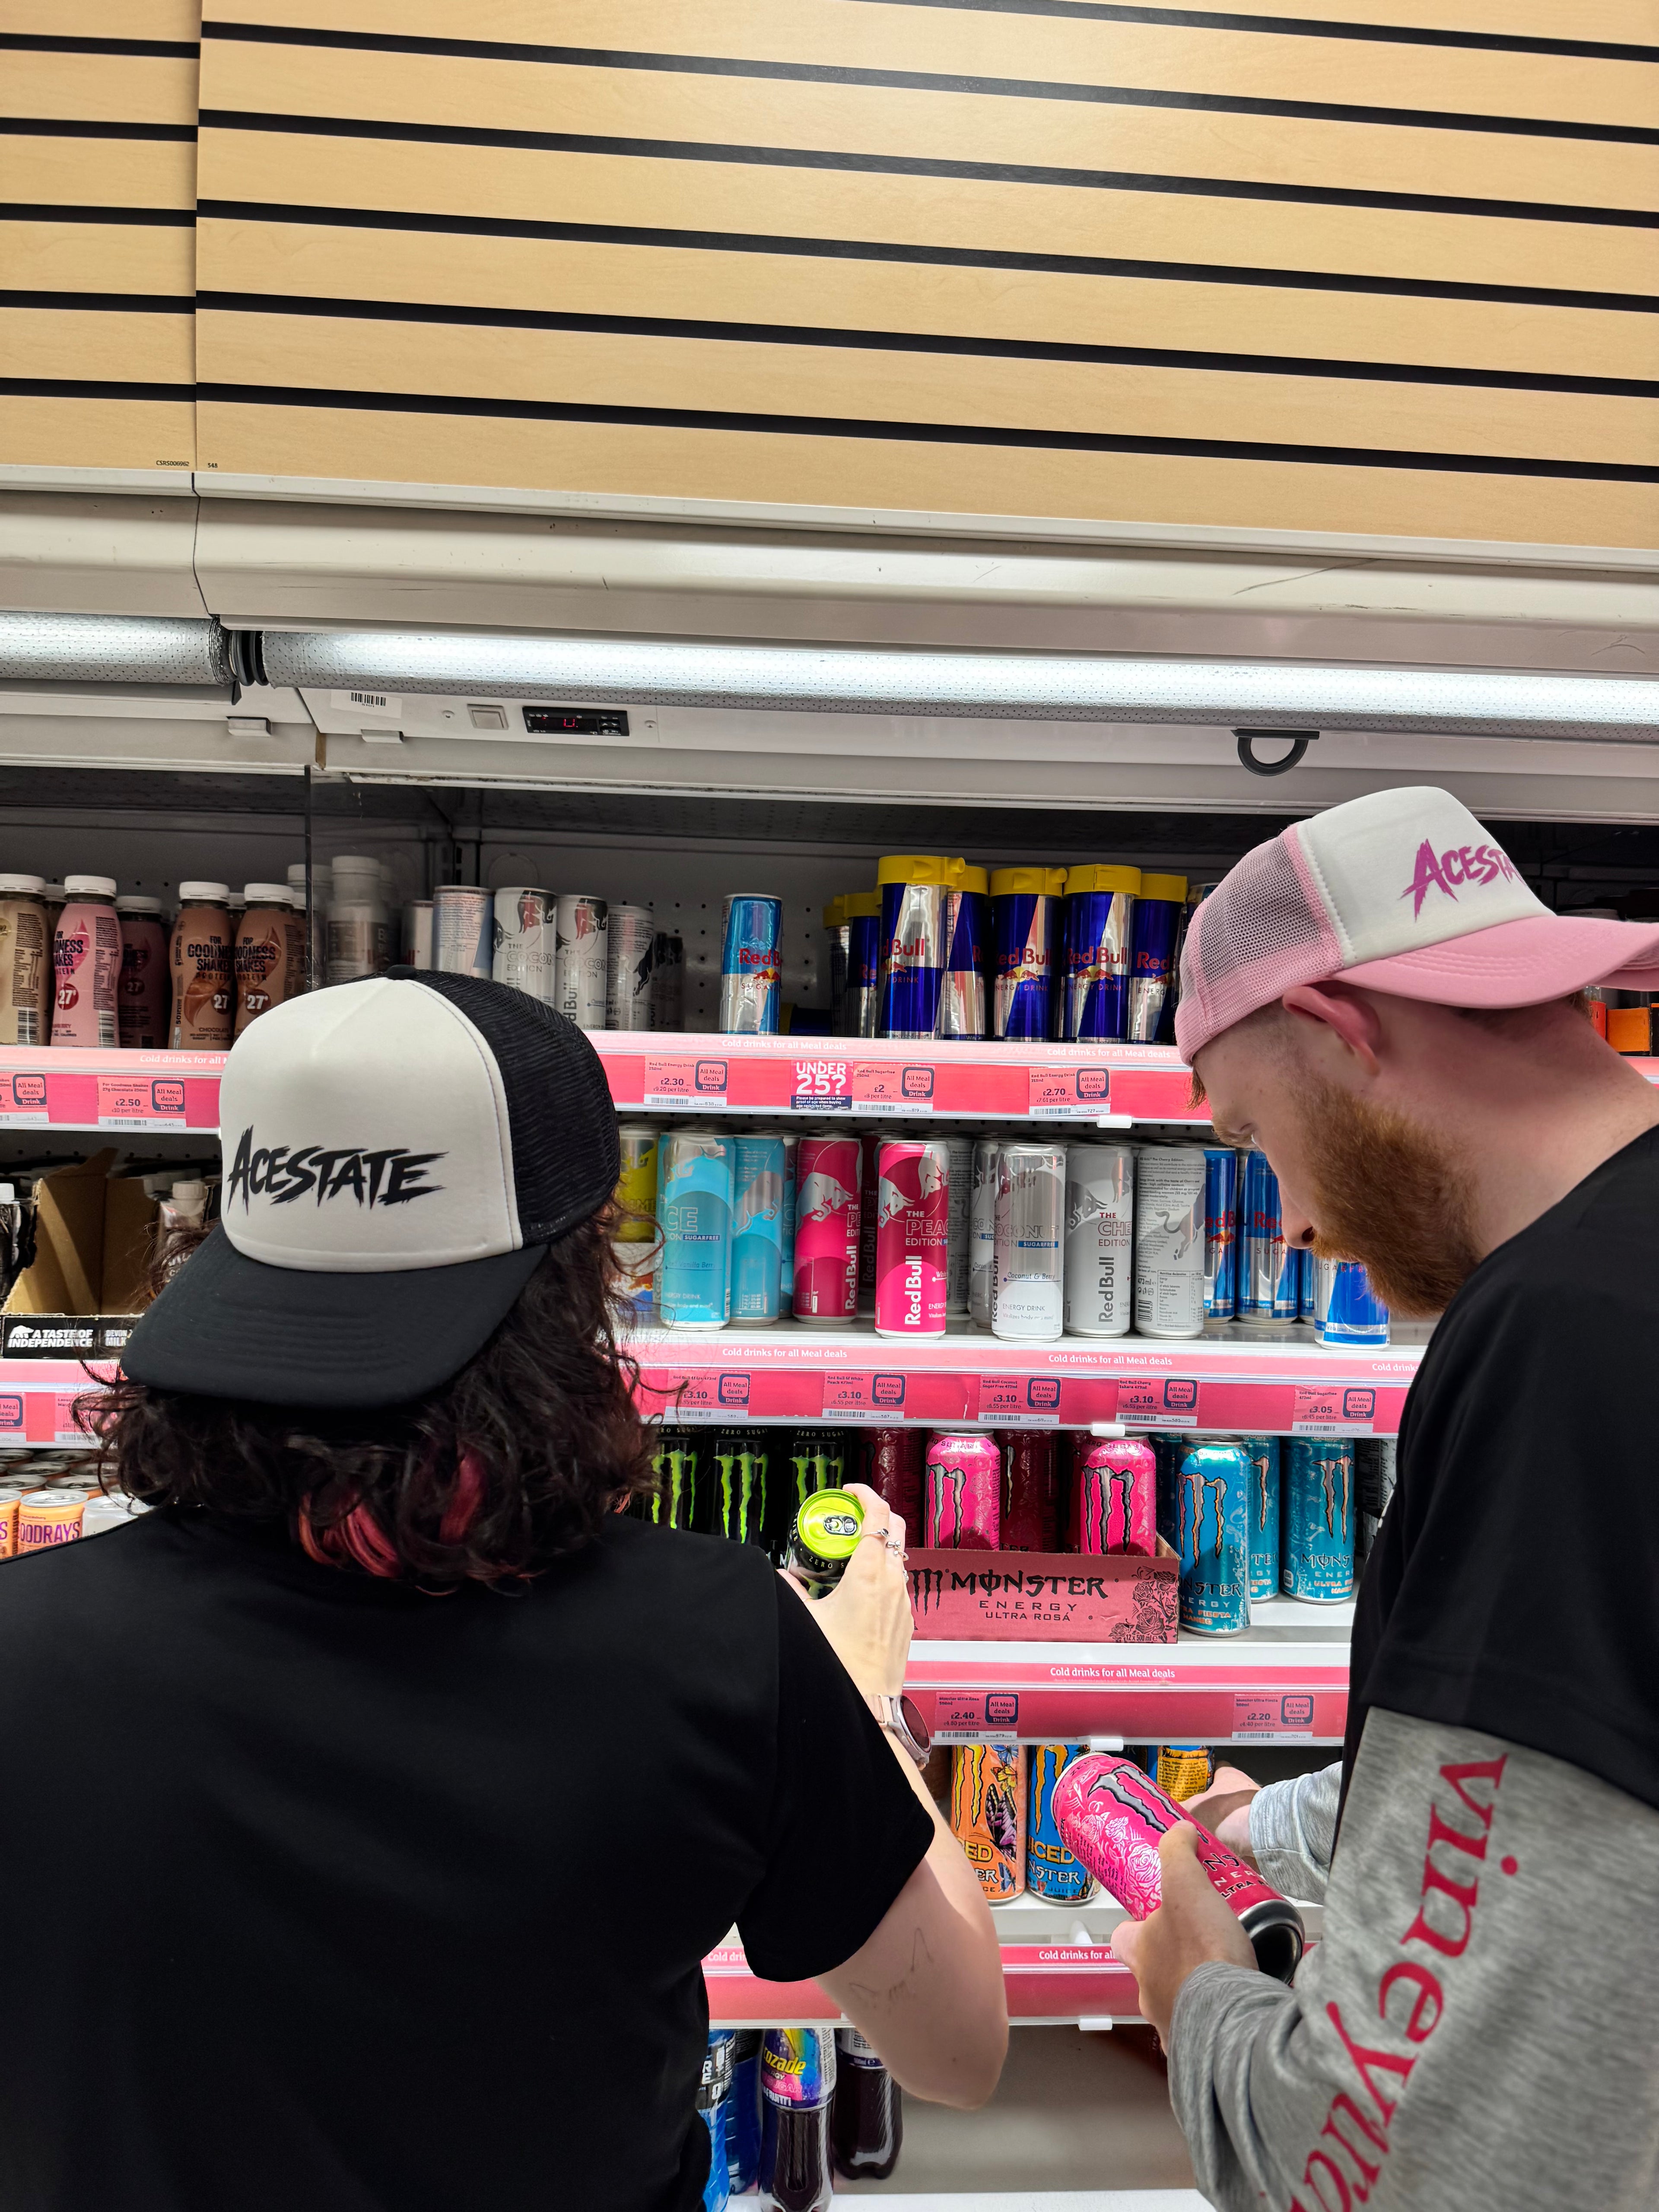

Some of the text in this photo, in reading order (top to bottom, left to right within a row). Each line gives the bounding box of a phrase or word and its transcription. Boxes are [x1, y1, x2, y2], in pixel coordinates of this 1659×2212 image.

[891, 938, 925, 956] Bull
[739, 948, 770, 966] Red
[1096, 947, 1127, 964] Bull
[722, 1039, 847, 1050] Cold drinks for all Meal deals
[140, 1055, 222, 1065] Cold drinks for all
[1147, 1050, 1170, 1058] deals
[796, 1061, 846, 1075] UNDER
[796, 1074, 846, 1095] 25?
[874, 1084, 884, 1093] £2
[227, 1125, 449, 1216] ACESTATE
[906, 1238, 942, 1246] EDITION
[846, 1245, 857, 1276] Bull
[906, 1255, 922, 1288] Bull
[1099, 1256, 1114, 1287] Bull
[845, 1278, 856, 1309] Red
[904, 1290, 922, 1325] Red
[1098, 1290, 1113, 1322] Red
[32, 1329, 93, 1338] A TASTE OF
[8, 1338, 93, 1348] INDEPENDENCE
[722, 1348, 847, 1358] Cold drinks for all Meal deals
[1069, 1355, 1097, 1363] drinks
[1100, 1356, 1112, 1364] for
[1126, 1357, 1147, 1365] Meal
[1149, 1357, 1172, 1366] deals
[809, 1556, 833, 1568] ZERO
[951, 1569, 1108, 1599] MONSTER
[979, 1600, 1077, 1612] ENERGY
[985, 1611, 1070, 1622] ULTRA ROSÁ
[1050, 1668, 1175, 1678] Cold drinks for all Meal deals
[708, 1951, 728, 1962] Cold
[1039, 1950, 1103, 1960] Cold drinks for
